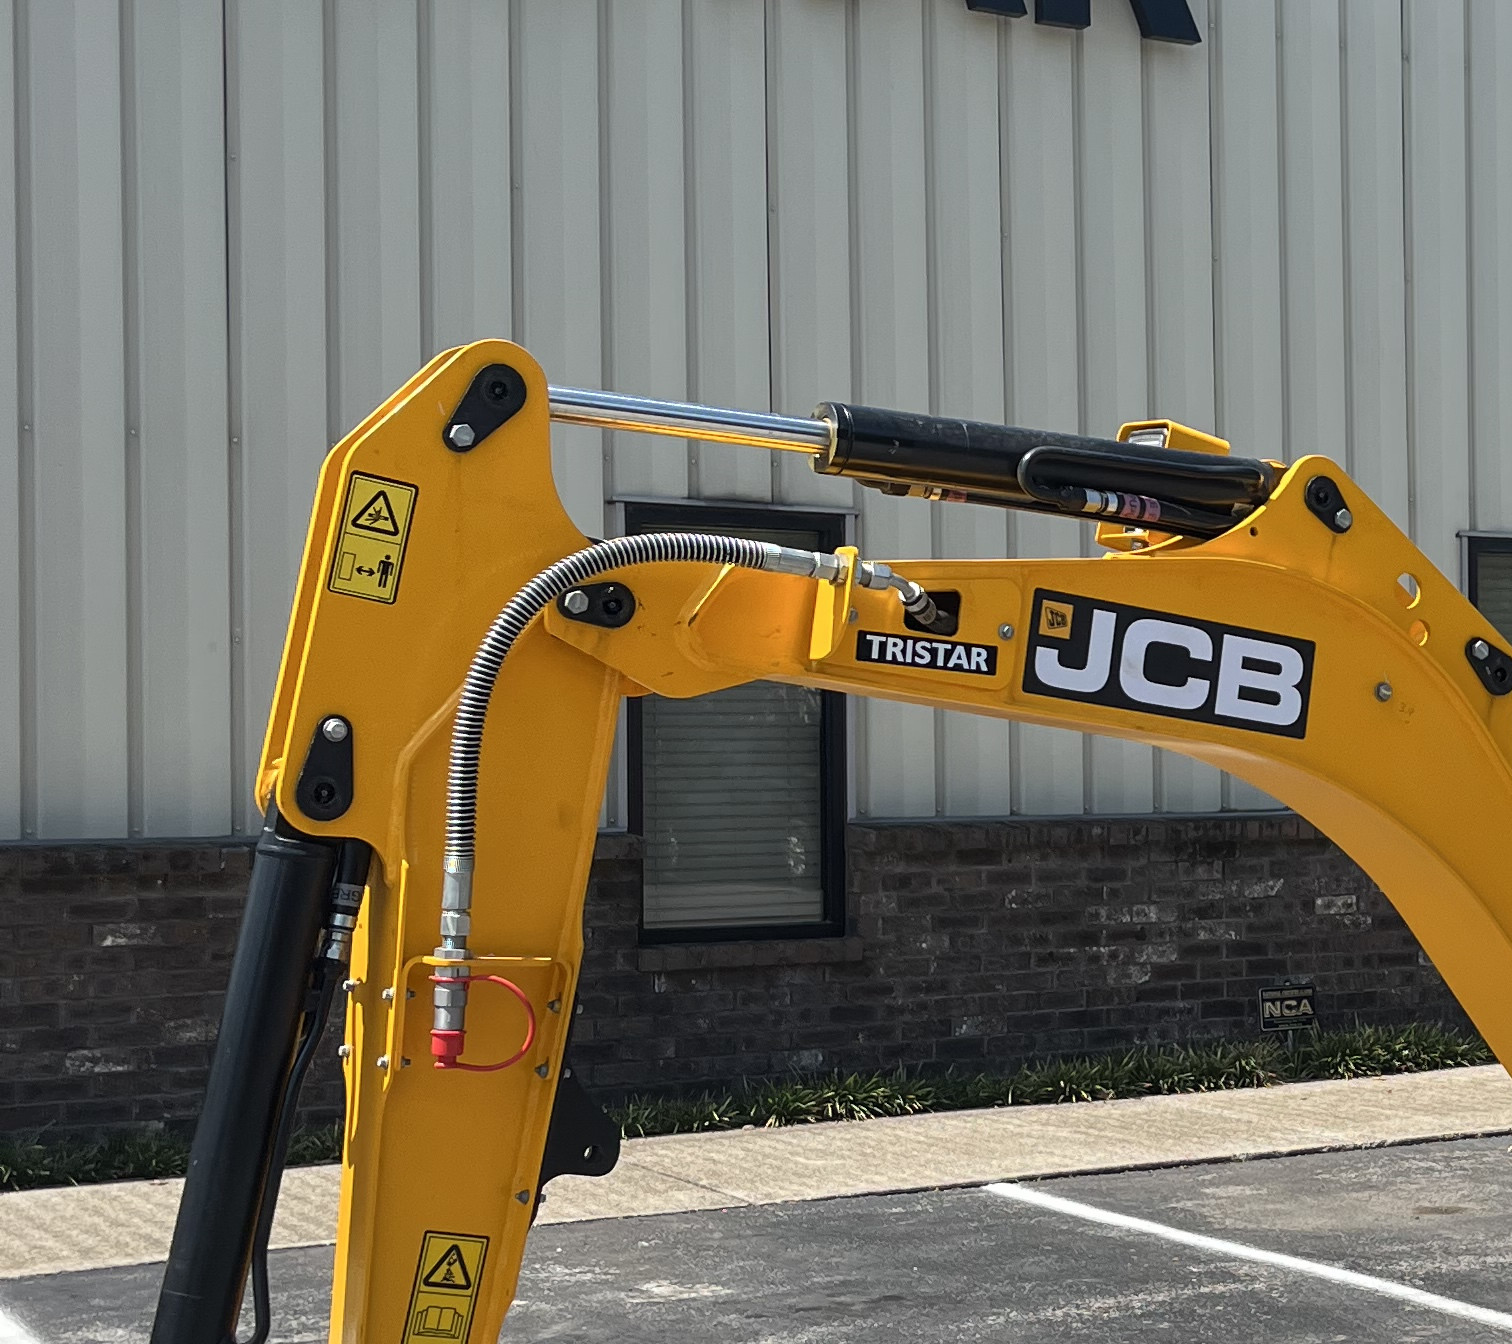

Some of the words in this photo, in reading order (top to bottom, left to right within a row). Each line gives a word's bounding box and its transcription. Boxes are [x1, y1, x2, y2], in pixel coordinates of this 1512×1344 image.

[866, 635, 989, 672] TRISTAR
[1035, 609, 1304, 726] JCB
[1264, 999, 1314, 1017] NCA
